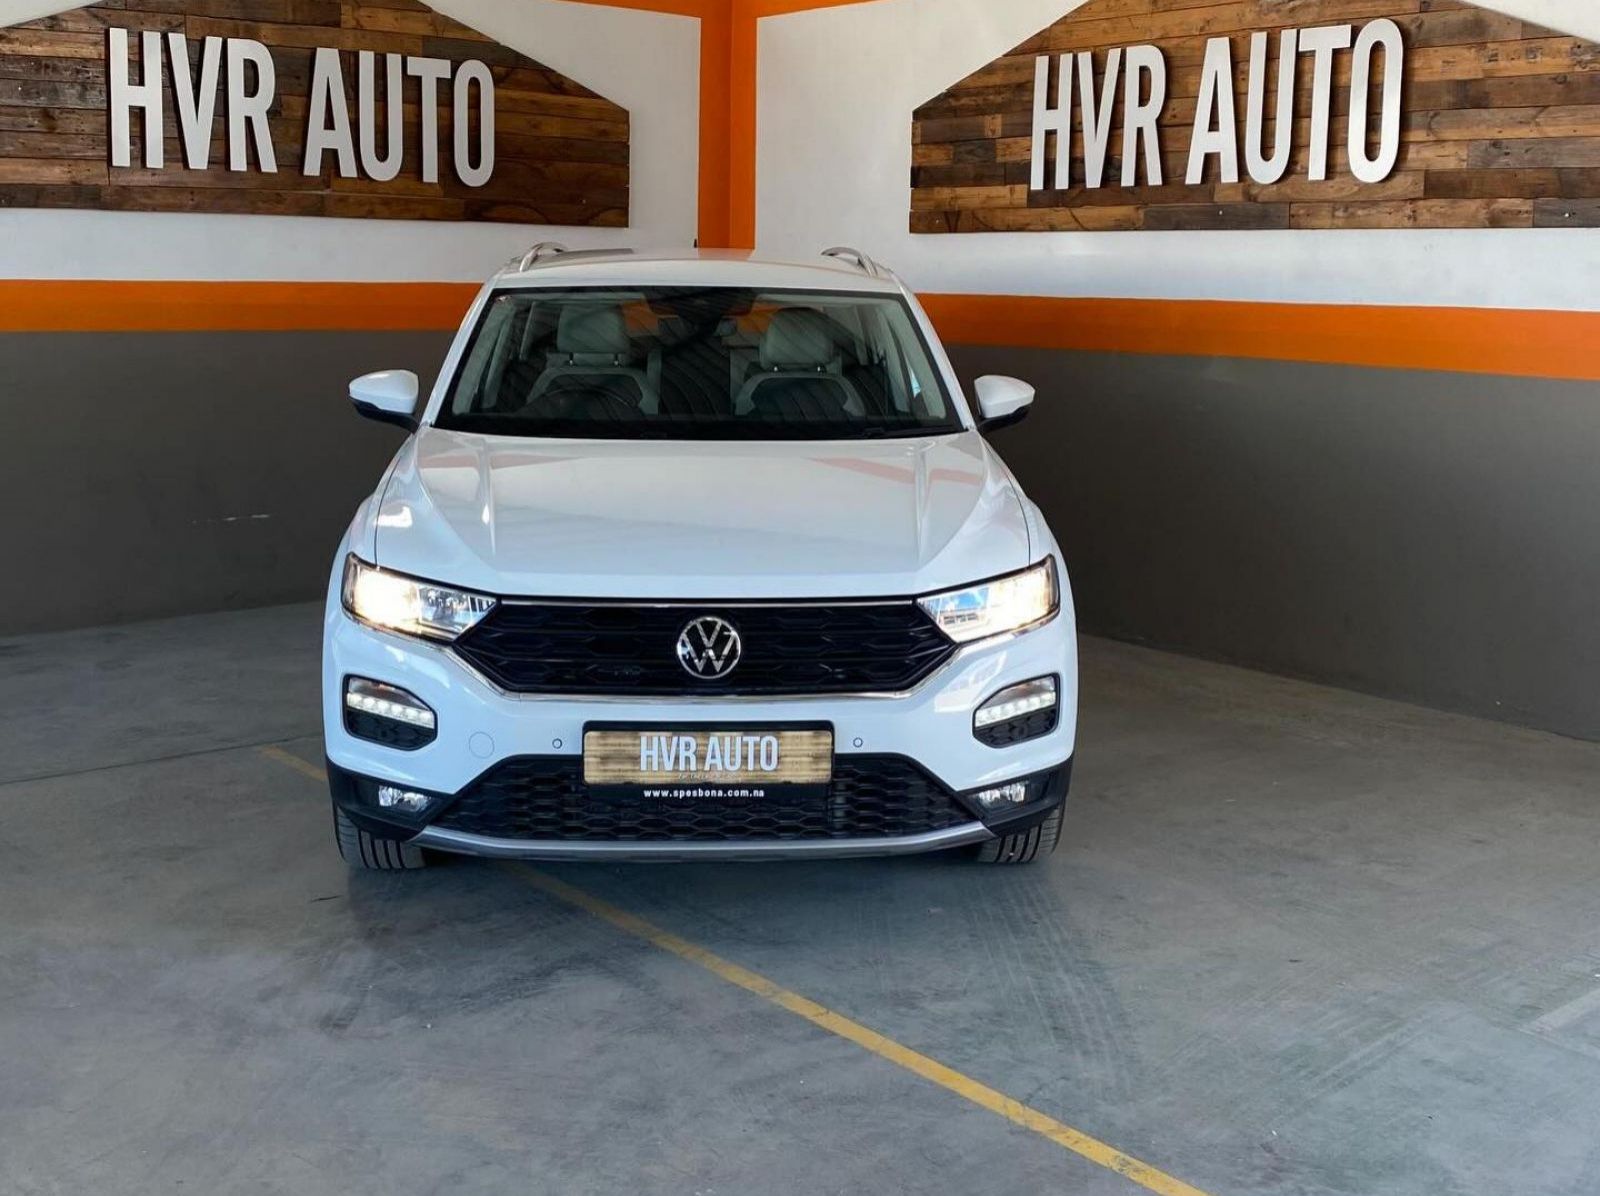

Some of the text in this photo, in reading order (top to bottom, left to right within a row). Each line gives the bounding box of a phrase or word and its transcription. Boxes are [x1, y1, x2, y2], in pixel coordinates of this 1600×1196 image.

[109, 27, 496, 188] HVR AUTO
[1030, 18, 1405, 191] HVR AUTO
[639, 735, 779, 772] HVR AUTO
